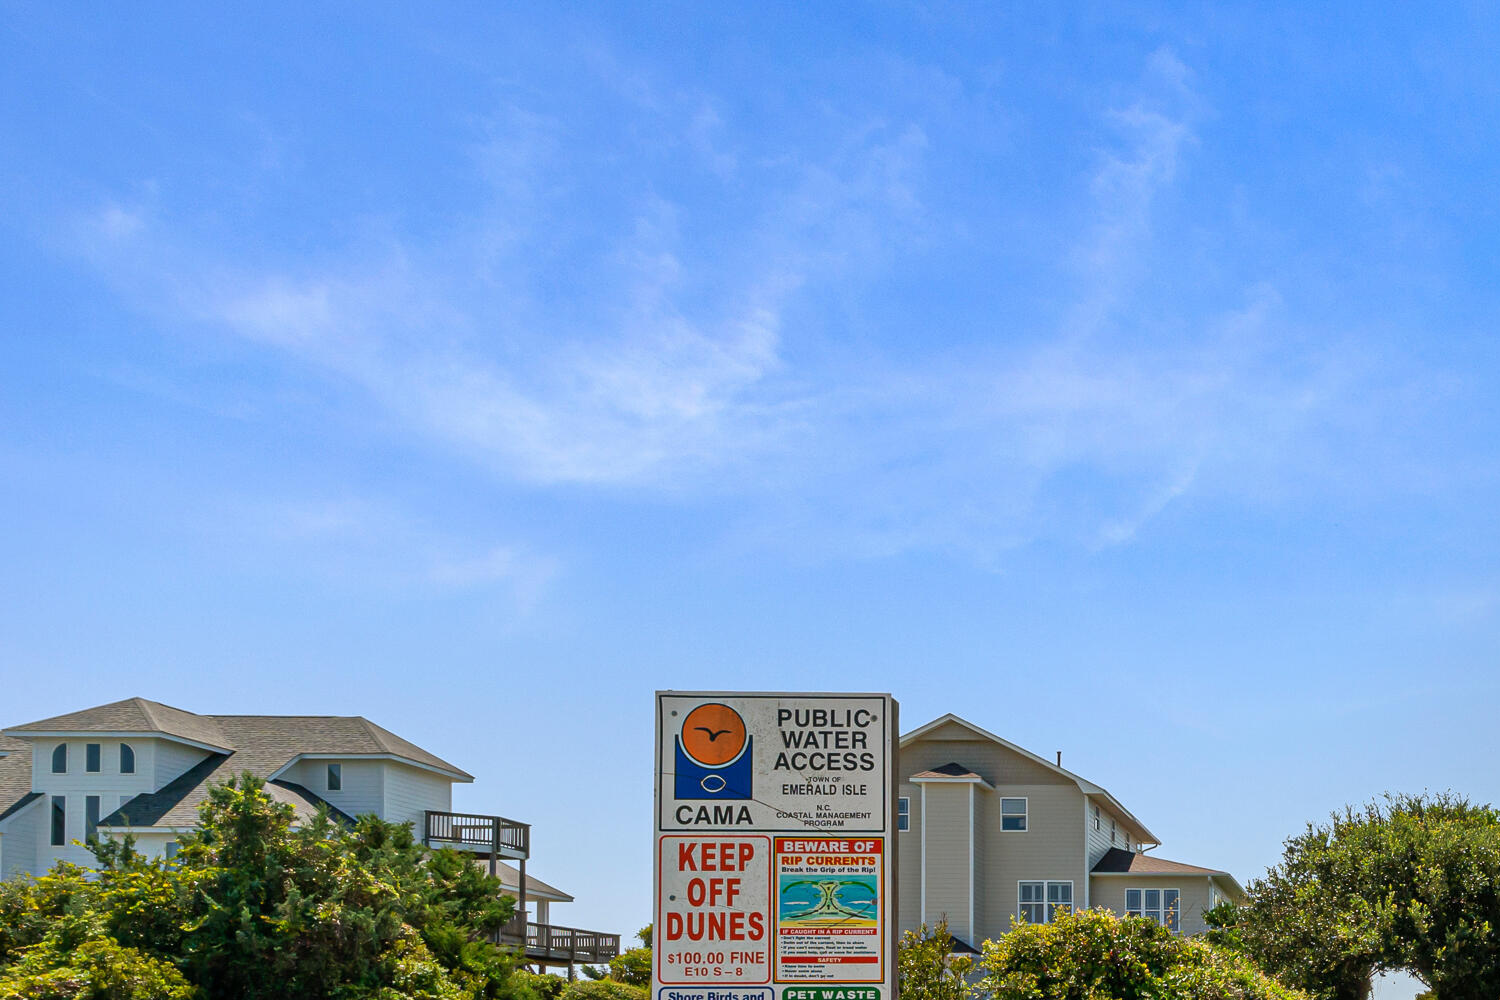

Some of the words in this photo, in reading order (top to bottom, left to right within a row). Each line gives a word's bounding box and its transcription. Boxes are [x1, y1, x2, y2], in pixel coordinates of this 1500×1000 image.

[778, 709, 870, 727] PUBLIC
[781, 731, 867, 749] WATER
[774, 752, 875, 771] ACCESS
[782, 784, 837, 795] EMERALD
[842, 784, 867, 795] ISLE
[675, 805, 753, 825] CAMA
[783, 841, 849, 852] BEWARE
[854, 841, 875, 852] OF
[678, 842, 755, 872] KEEP
[781, 856, 803, 866] RIP
[806, 856, 876, 866] CURRENTS
[687, 877, 741, 907] OFF
[666, 911, 765, 941] DUNES
[667, 952, 724, 964] $100.00
[730, 952, 765, 964] FINE
[684, 967, 708, 976] E10
[787, 990, 817, 1000] PET
[821, 990, 876, 1000] WASTE
